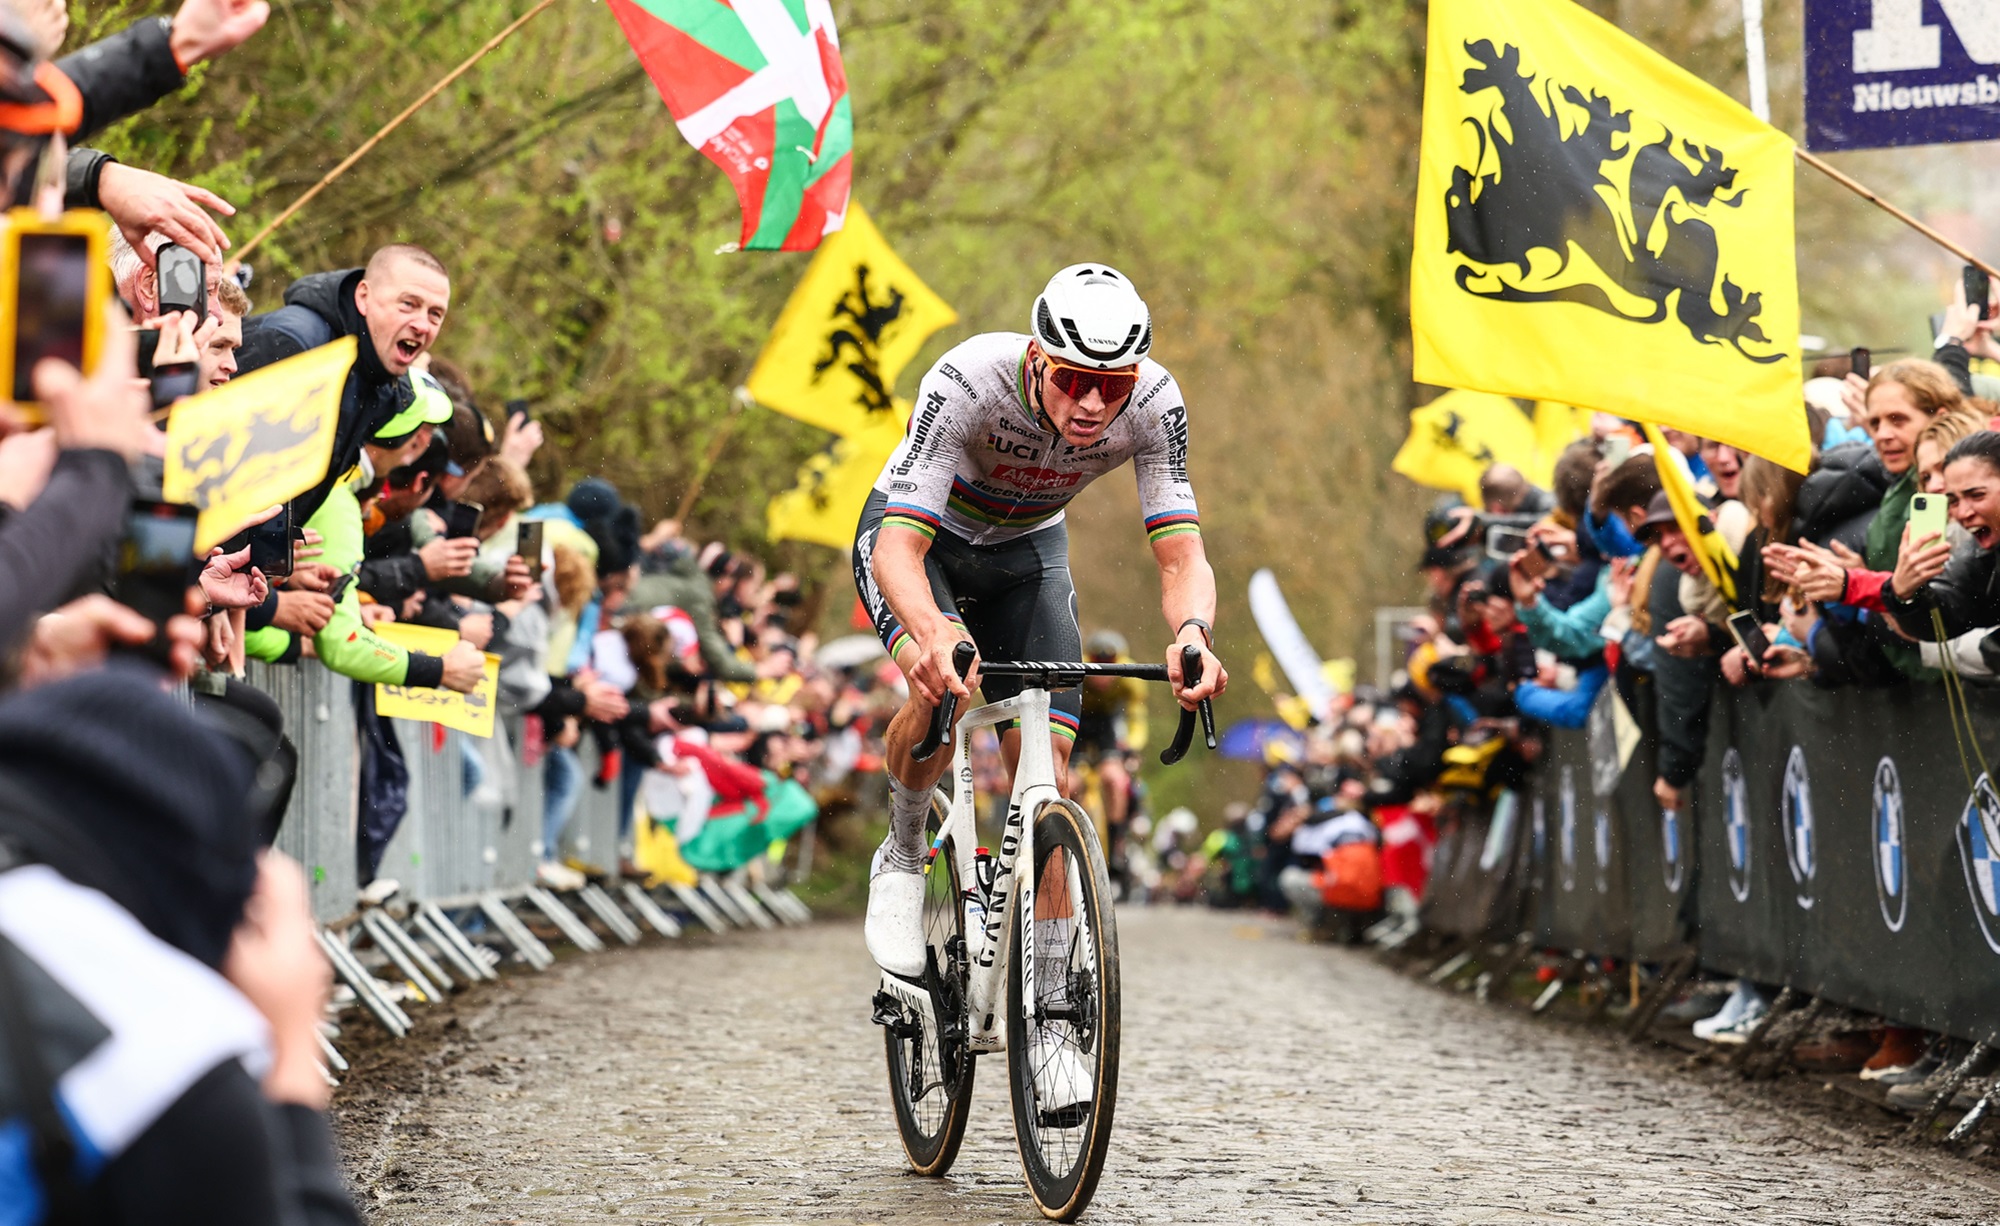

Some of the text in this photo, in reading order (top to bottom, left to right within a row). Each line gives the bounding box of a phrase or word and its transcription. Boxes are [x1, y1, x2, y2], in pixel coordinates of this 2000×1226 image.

[1853, 74, 2000, 113] Nieuwsb
[1088, 337, 1118, 346] CANYON
[896, 390, 947, 476] deceuninck
[995, 435, 1039, 461] UCI
[1062, 451, 1109, 464] CANYON
[1001, 468, 1070, 487] Alpecin
[979, 803, 1021, 967] CANYON
